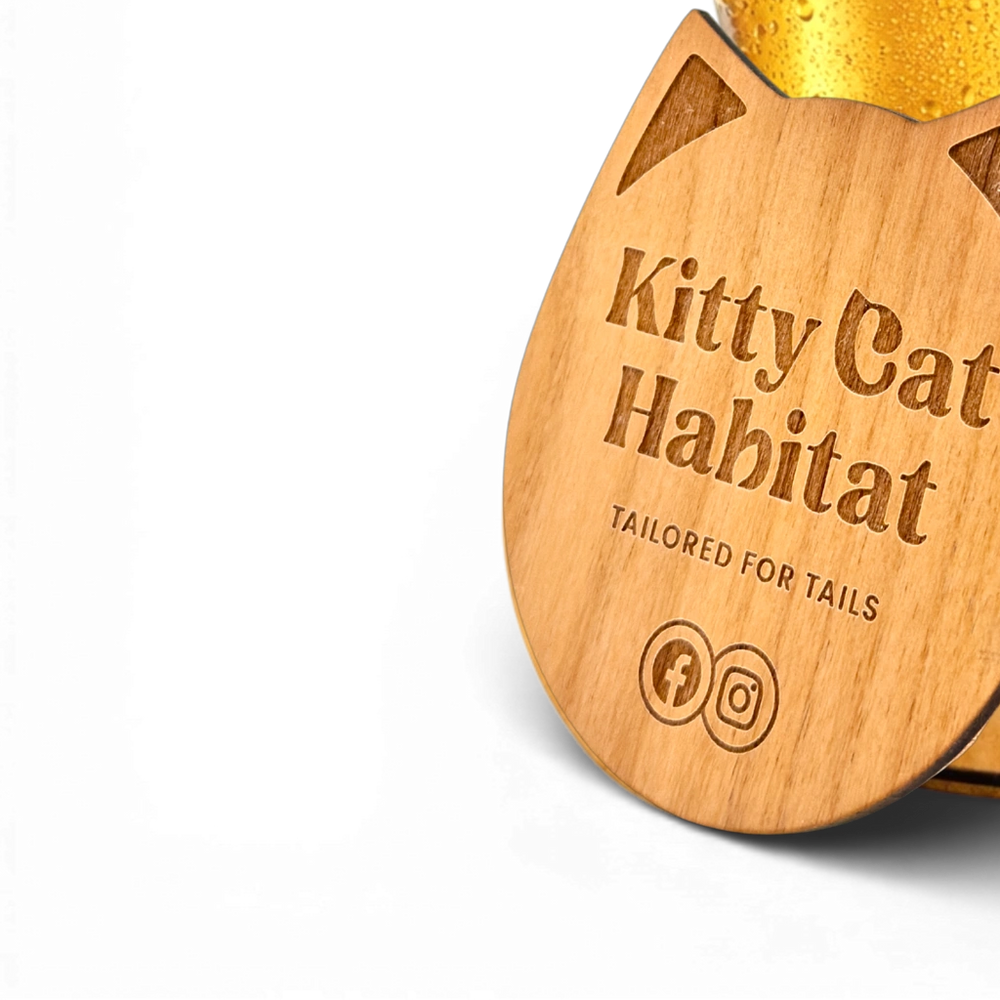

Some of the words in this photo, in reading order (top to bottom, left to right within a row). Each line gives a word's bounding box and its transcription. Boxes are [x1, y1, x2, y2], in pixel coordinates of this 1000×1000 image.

[605, 246, 822, 393] Kitty
[834, 288, 1000, 428] Cat
[603, 364, 938, 546] Habitat
[611, 504, 733, 568] TAILORED
[741, 550, 795, 591] FOR
[805, 571, 880, 622] TAILS
